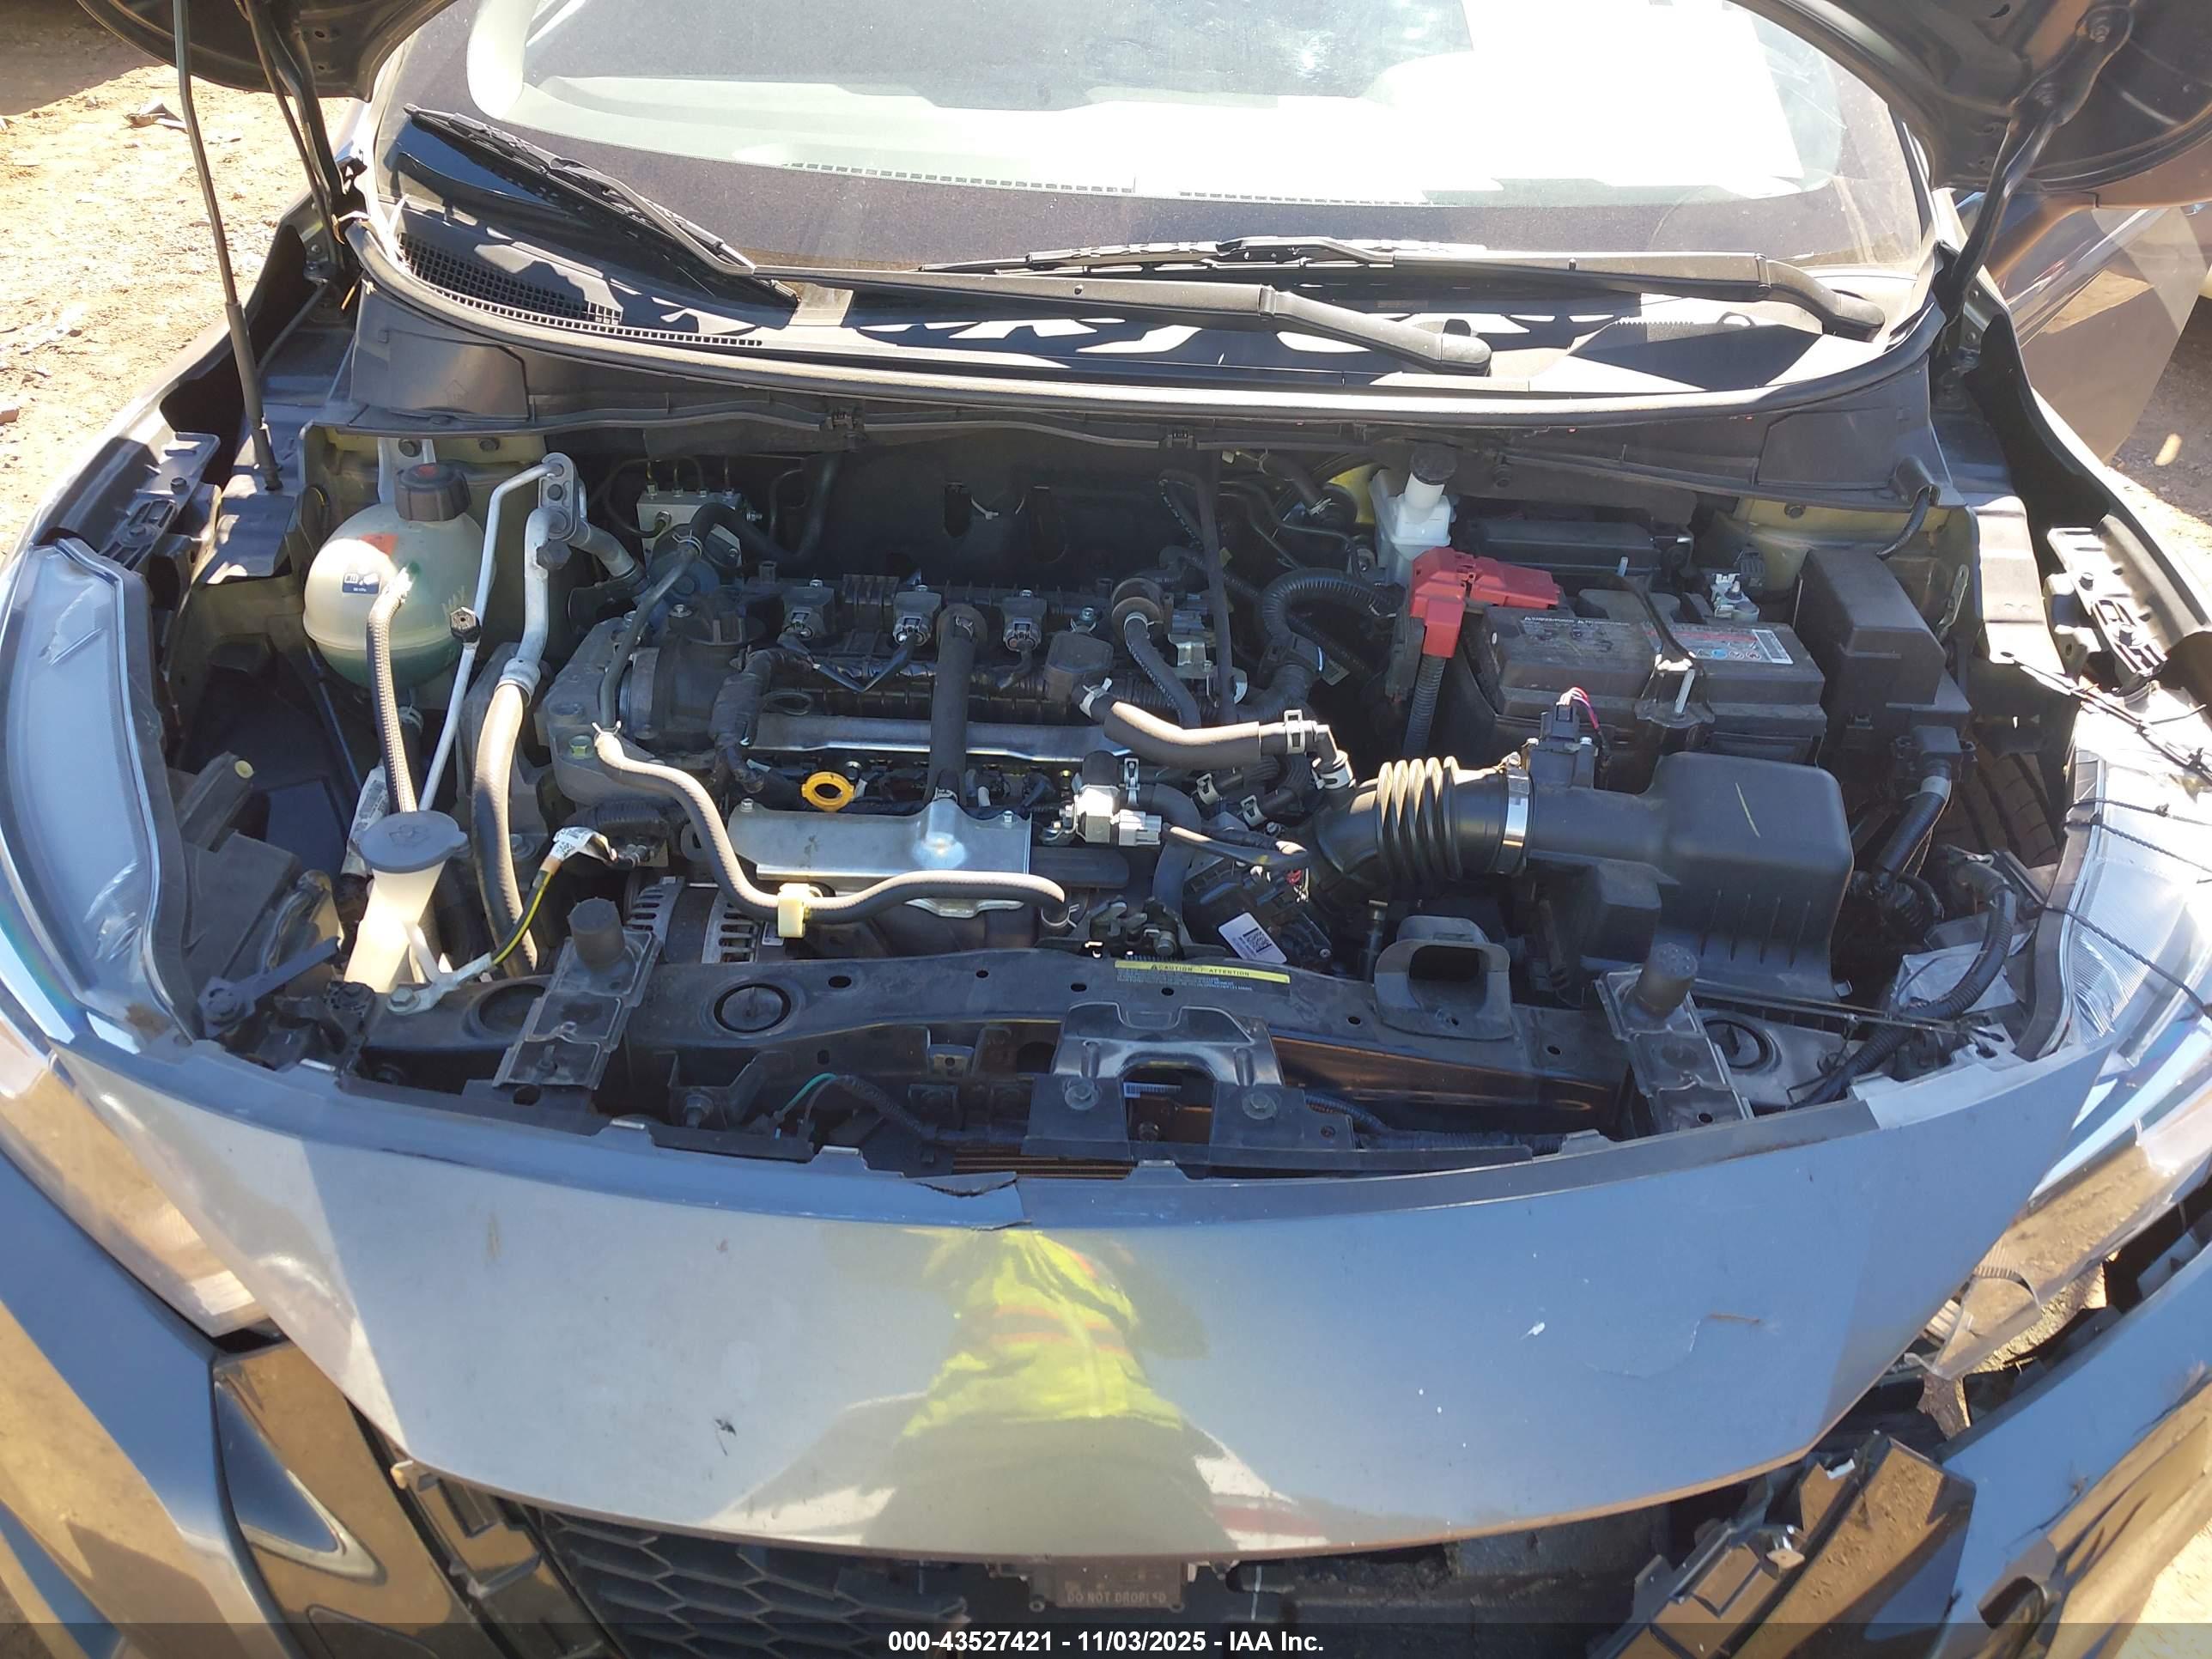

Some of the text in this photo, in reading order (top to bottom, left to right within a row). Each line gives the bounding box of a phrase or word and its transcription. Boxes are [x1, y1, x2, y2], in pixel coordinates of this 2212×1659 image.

[1208, 968, 1250, 976] ATTENTION
[1067, 1593, 1084, 1602] DO
[1087, 1593, 1111, 1603] NOT
